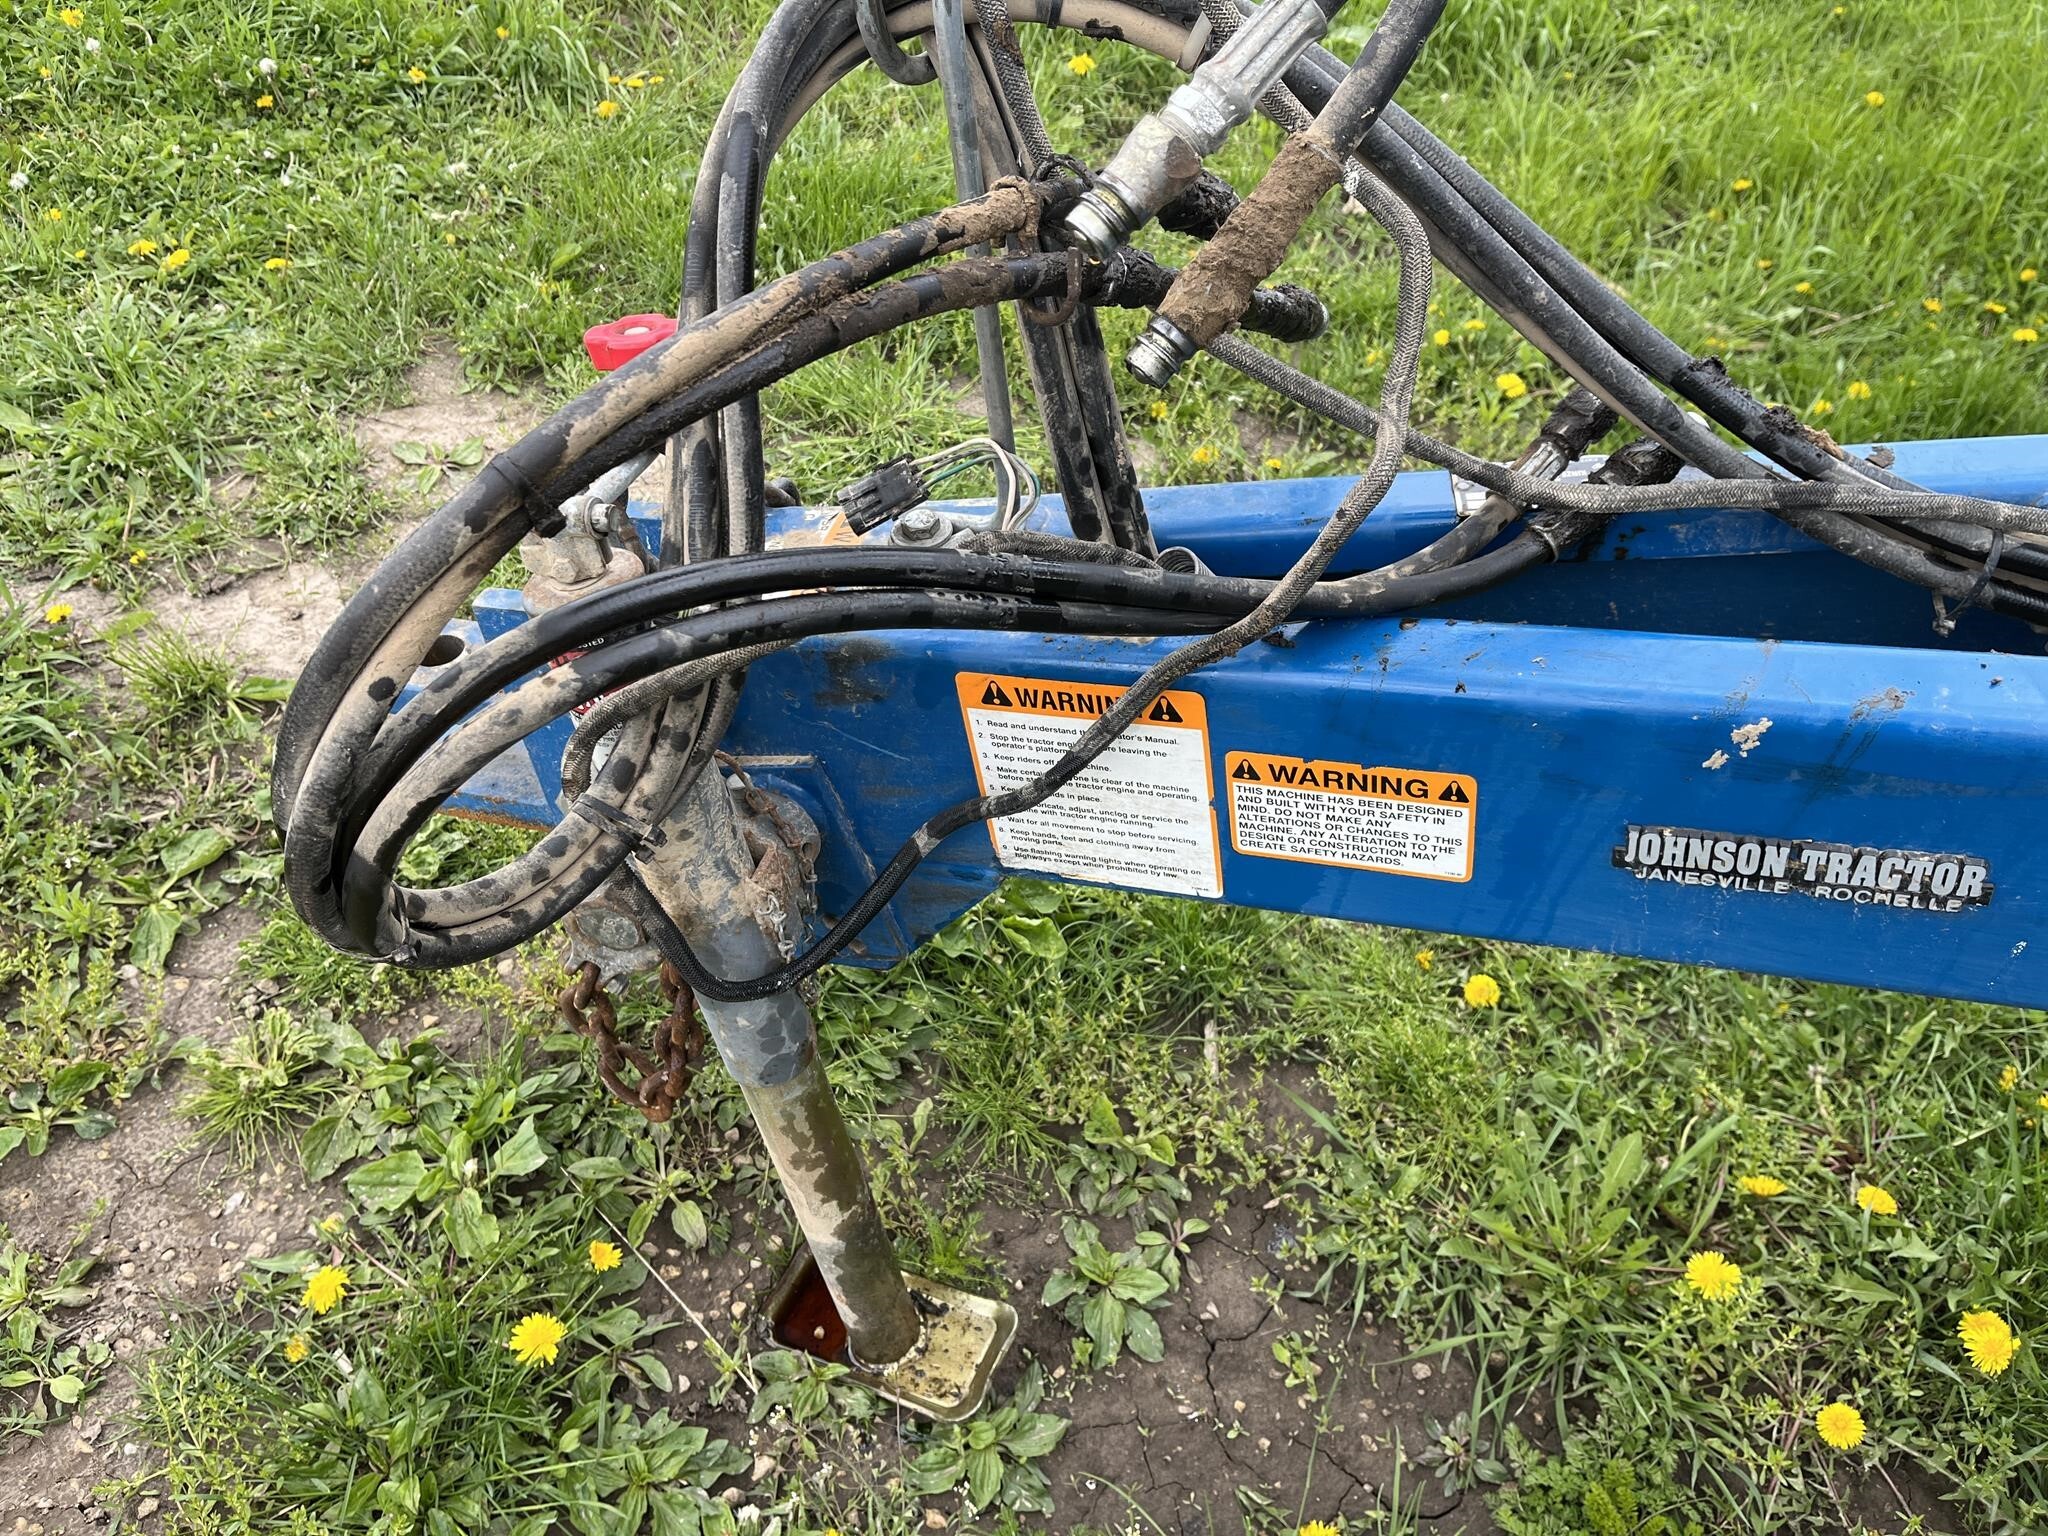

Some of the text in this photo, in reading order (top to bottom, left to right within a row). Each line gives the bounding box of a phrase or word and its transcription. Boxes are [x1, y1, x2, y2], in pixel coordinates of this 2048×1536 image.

[987, 720, 1008, 728] Read
[1029, 725, 1077, 735] understand
[990, 734, 1008, 742] Stop
[1026, 738, 1054, 746] tractor
[992, 741, 1033, 750] operator's
[1119, 747, 1150, 756] leaving
[994, 754, 1014, 762] Keep
[1153, 784, 1189, 793] machine
[1268, 764, 1428, 799] WARNING
[1078, 795, 1102, 803] place.
[1106, 786, 1135, 794] engine
[1156, 791, 1199, 802] operating.
[1236, 785, 1463, 817] THIS MACHINE HAS BEEN DESIGNED
[1069, 806, 1096, 814] adjust,
[1099, 809, 1128, 819] unclog
[1142, 815, 1172, 823] service
[1090, 815, 1118, 823] engine
[1237, 795, 1445, 825] AND BUILT WITH YOUR SAFETY IN
[1238, 804, 1392, 828] MIND. DO NOT MAKE ANY
[1011, 835, 1039, 844] moving
[1052, 822, 1094, 832] movement
[1108, 829, 1125, 837] stop
[1128, 831, 1155, 839] before
[1158, 835, 1199, 846] servicing.
[1239, 813, 1462, 846] ALTERATIONS OR CHANGES TO THIS
[1239, 822, 1456, 854] MACHINE. ANY ALTERATION TO THE
[1032, 831, 1059, 839] hands,
[1096, 839, 1129, 849] clothing
[1132, 844, 1153, 852] away
[1156, 846, 1175, 854] from
[1240, 831, 1438, 861] DESIGN OR CONSTRUCTION MAY
[1240, 840, 1404, 866] CREATE SAFETY HAZARDS.
[1015, 853, 1051, 861] highways
[1107, 865, 1148, 874] prohibited
[1030, 848, 1062, 858] flashing
[1064, 853, 1096, 862] warning
[1099, 857, 1121, 865] lights
[1149, 864, 1188, 874] operating
[1625, 829, 1987, 898] JOHNSON TRACTOR
[1636, 867, 1964, 913] JANESVILLE ROCHELLE
